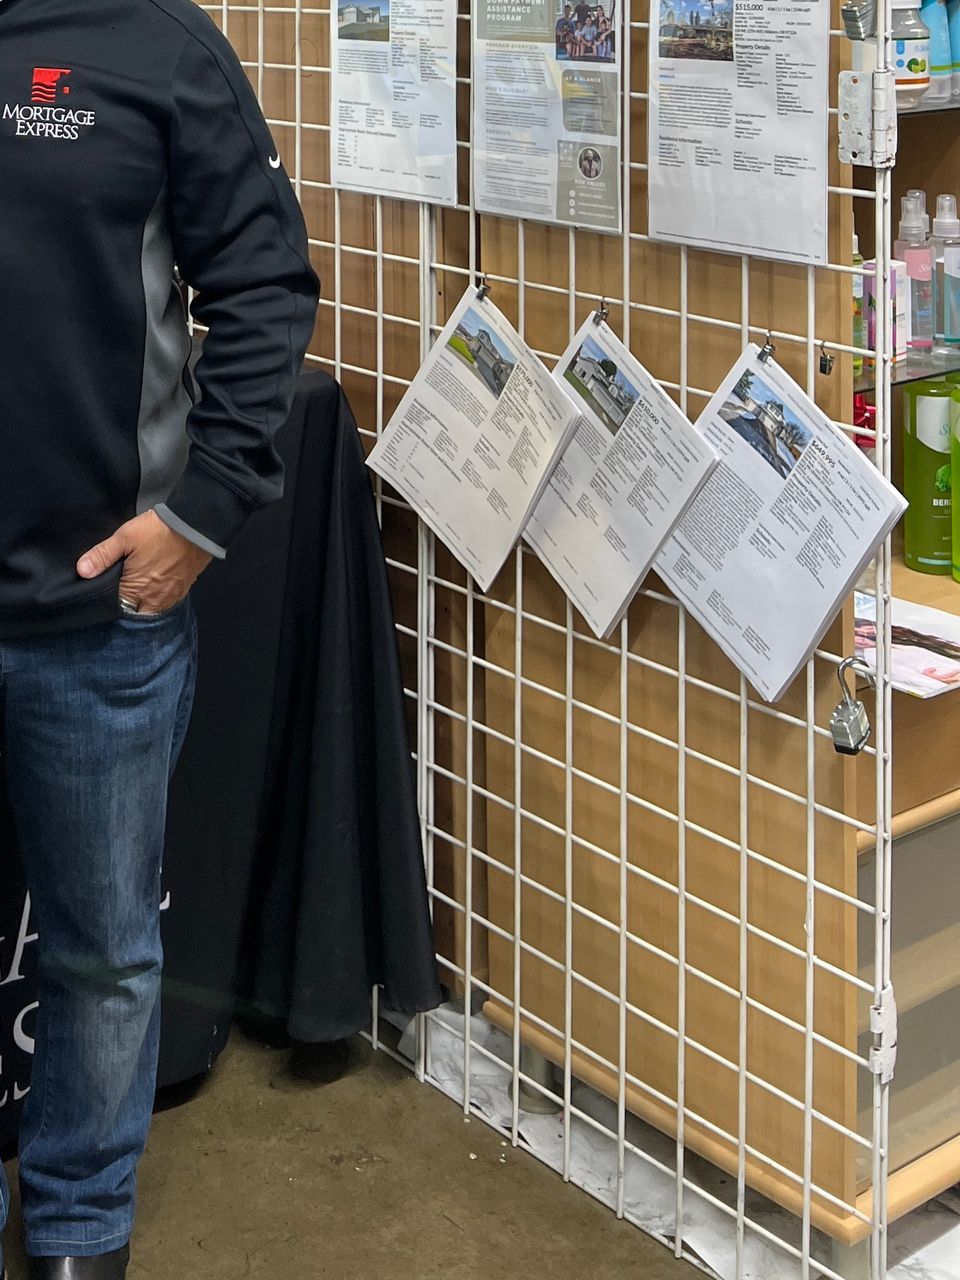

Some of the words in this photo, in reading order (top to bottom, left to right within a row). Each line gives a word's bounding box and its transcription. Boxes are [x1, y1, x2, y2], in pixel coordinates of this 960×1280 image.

[486, 5, 532, 14] ASSISTANCE
[735, 3, 764, 12] $515,000
[486, 13, 522, 22] PROGRAM
[2, 103, 95, 126] MORTGAGE
[15, 120, 78, 140] EXPRESS
[809, 439, 836, 468] $649,995
